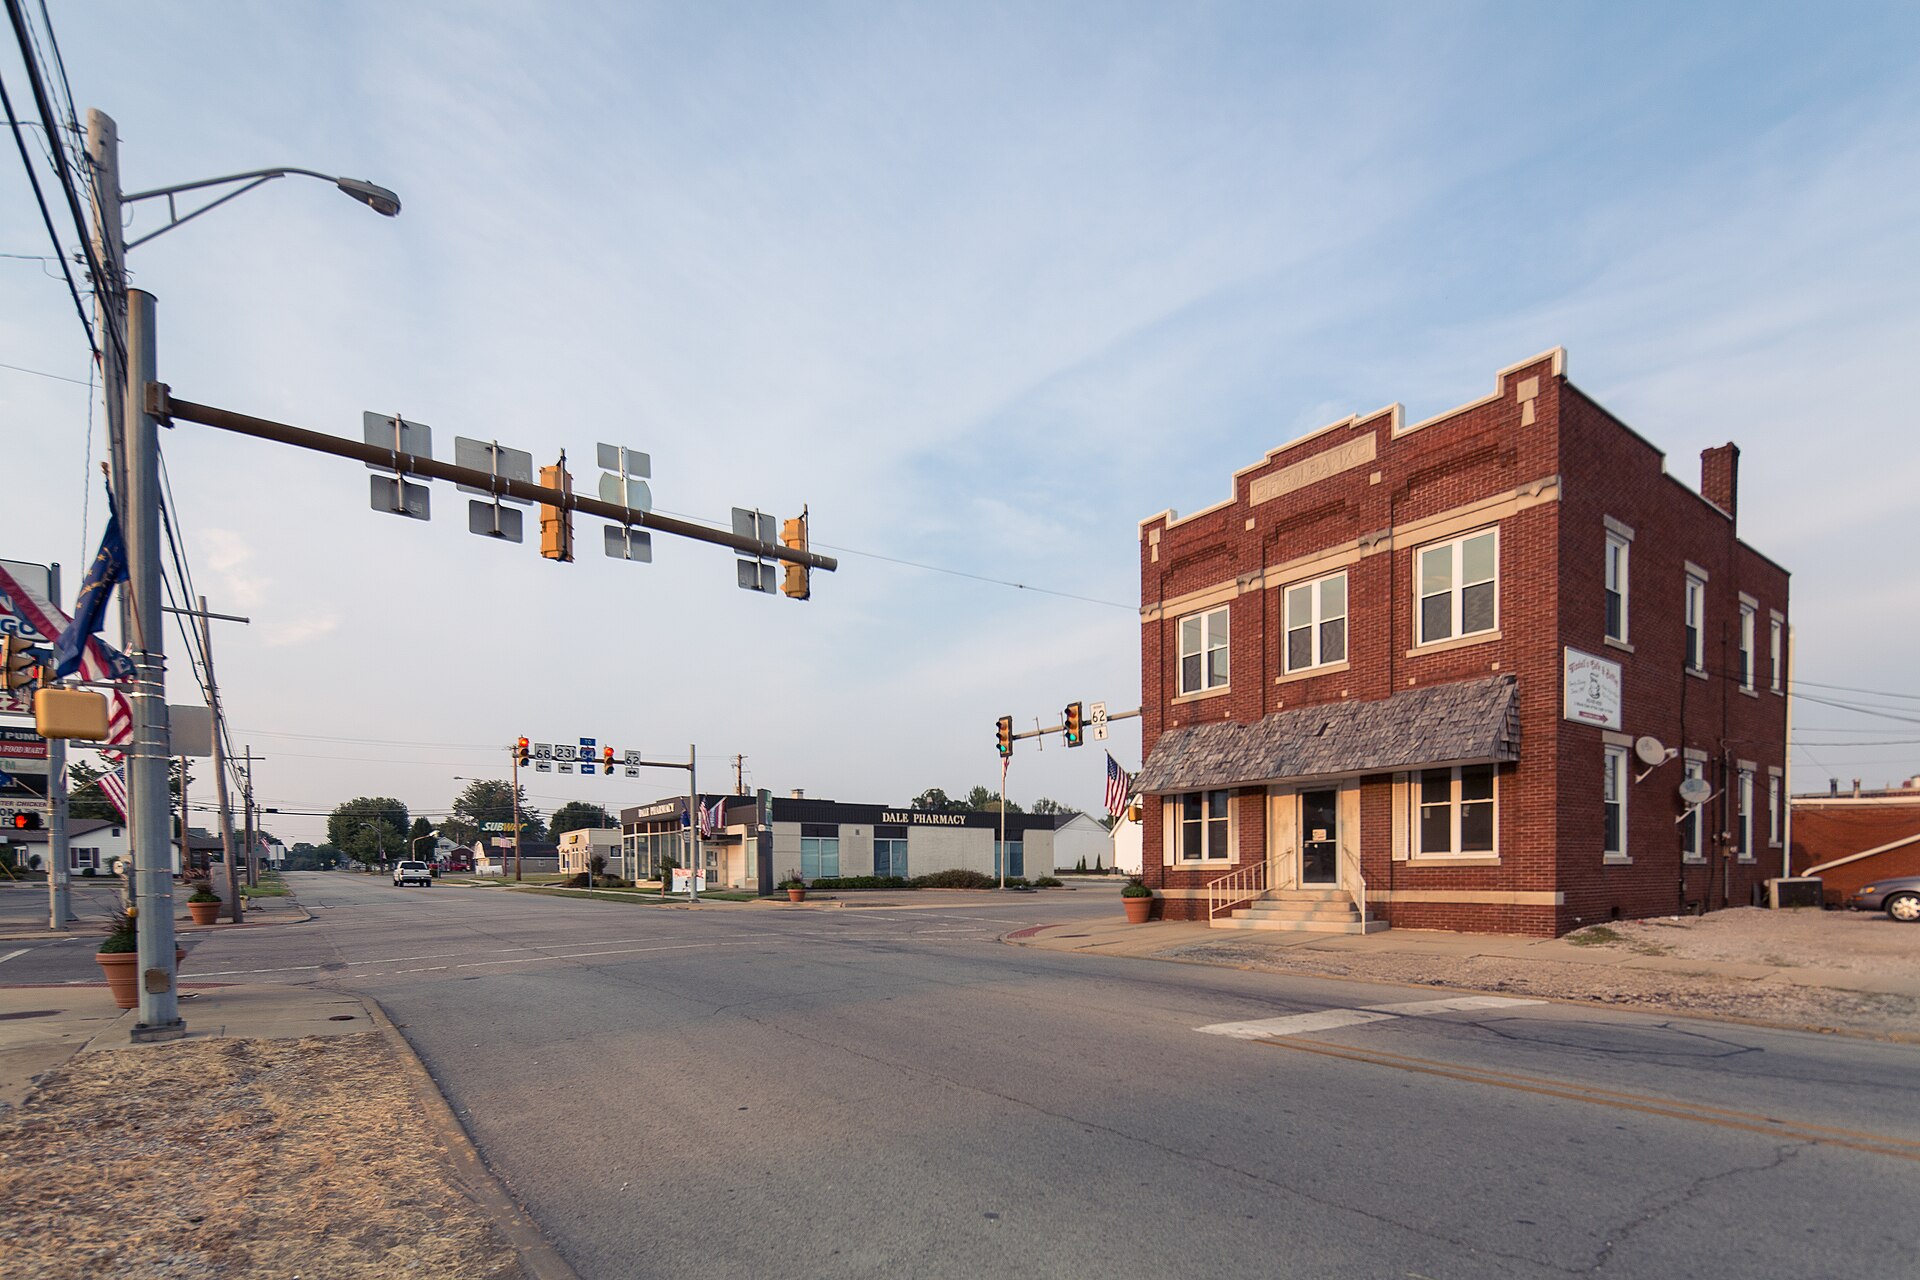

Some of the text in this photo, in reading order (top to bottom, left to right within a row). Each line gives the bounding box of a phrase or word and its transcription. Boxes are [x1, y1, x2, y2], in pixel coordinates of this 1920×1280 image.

[1309, 446, 1354, 477] BANK
[1092, 710, 1105, 723] 62
[4, 745, 23, 753] FOOD
[536, 749, 551, 759] 68
[556, 748, 575, 758] 231
[581, 751, 594, 760] 64
[626, 756, 640, 765] 62
[882, 812, 966, 825] DALE PHARMACY
